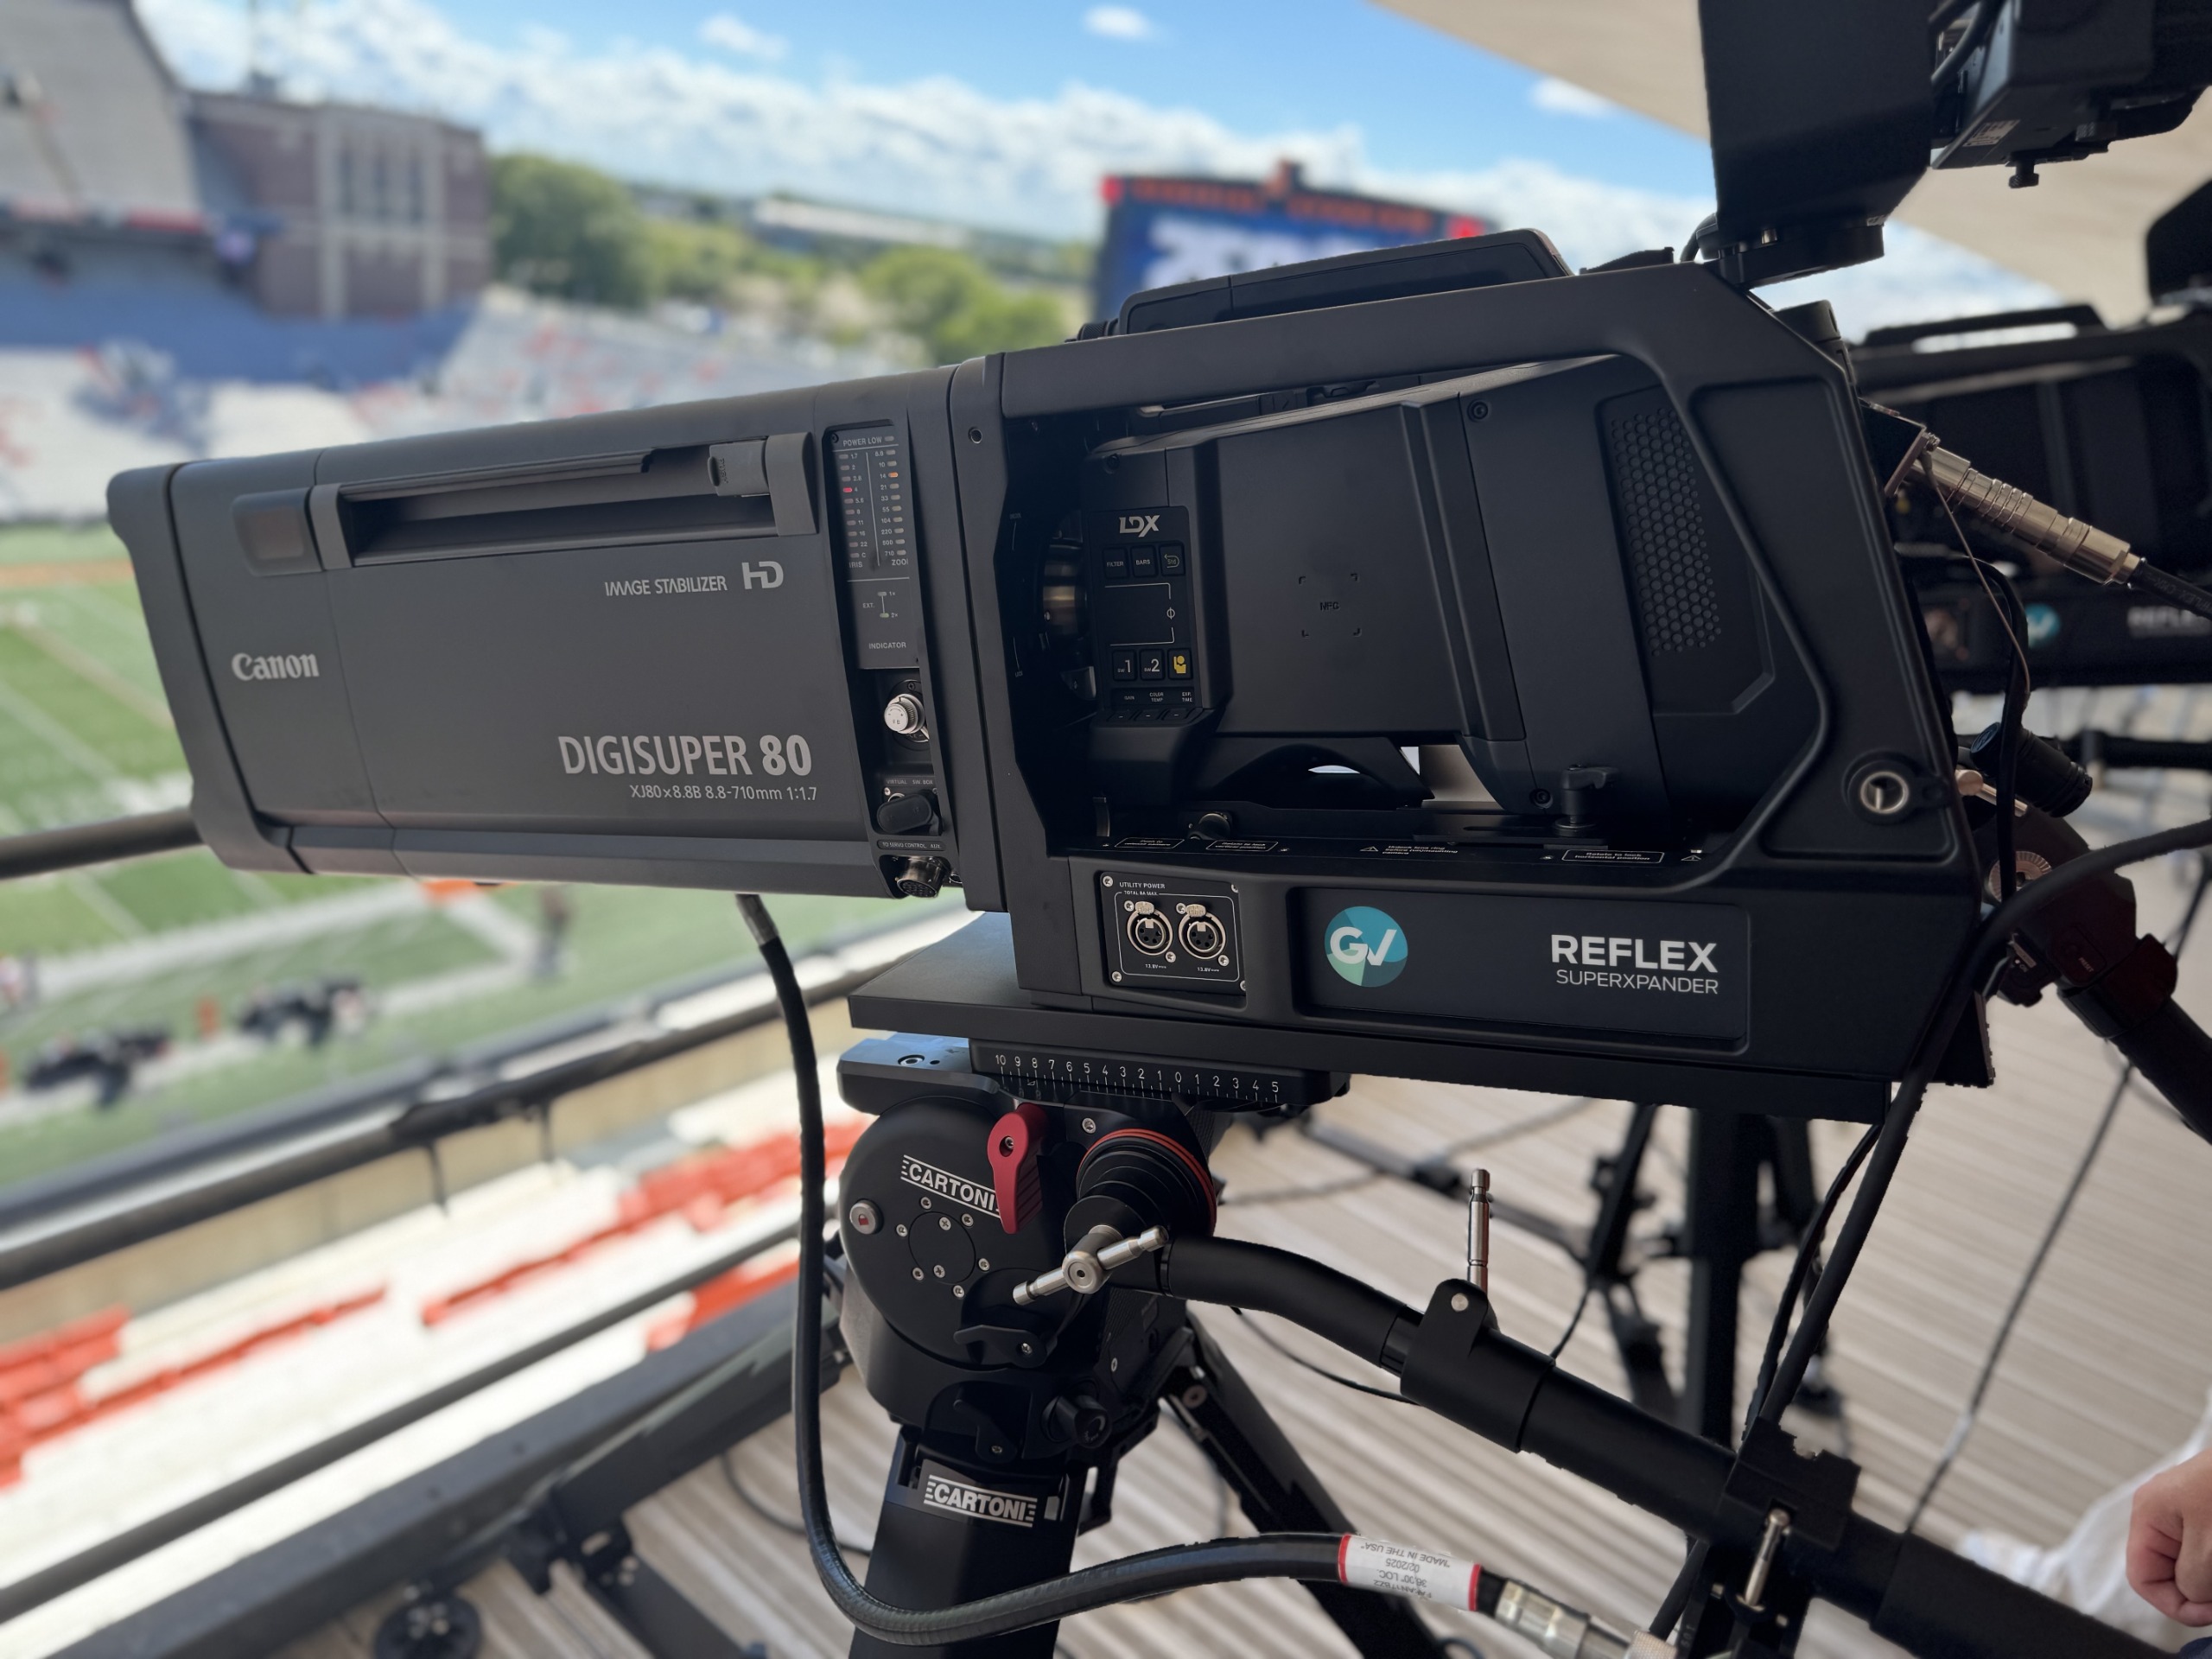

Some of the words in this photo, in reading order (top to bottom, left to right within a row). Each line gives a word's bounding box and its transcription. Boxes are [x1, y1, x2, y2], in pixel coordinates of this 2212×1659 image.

[842, 438, 867, 447] POWER
[868, 437, 882, 445] LOW
[1118, 515, 1160, 537] LDX
[892, 558, 909, 566] ZOO
[605, 580, 652, 596] IMAGE
[655, 575, 728, 594] STABILIZER
[741, 560, 785, 589] HD
[1320, 601, 1340, 611] NFC
[868, 642, 906, 650] INDICATOR
[231, 652, 320, 682] Canon
[558, 734, 753, 775] DIGISUPER
[760, 734, 812, 776] 80
[705, 785, 783, 800] 8.8-710mm
[786, 786, 817, 801] 1:1.7
[1329, 925, 1397, 966] GV
[1550, 933, 1719, 973] REFLEX
[1556, 969, 1719, 995] SUPERXPANDER
[995, 1055, 1006, 1065] 10
[1014, 1056, 1021, 1067] 9
[1031, 1057, 1038, 1068] 8
[1048, 1059, 1055, 1070] 7
[1066, 1061, 1073, 1072] 6
[1084, 1063, 1090, 1074] 5
[1102, 1065, 1109, 1075] 4
[1119, 1066, 1127, 1077] 3
[1138, 1068, 1145, 1079] 2
[1157, 1070, 1162, 1081] 1
[1175, 1071, 1182, 1083] 0
[1194, 1074, 1200, 1084] 1
[1212, 1075, 1220, 1087] 2
[1232, 1077, 1240, 1089] 3
[1252, 1080, 1259, 1090] 4
[1271, 1081, 1279, 1093] 5
[909, 1163, 995, 1211] CARTONI
[933, 1484, 1027, 1522] CARTONI
[1385, 1547, 1405, 1557] THE
[1376, 1568, 1399, 1581] LOC.
[1385, 1557, 1421, 1573] 02/2025
